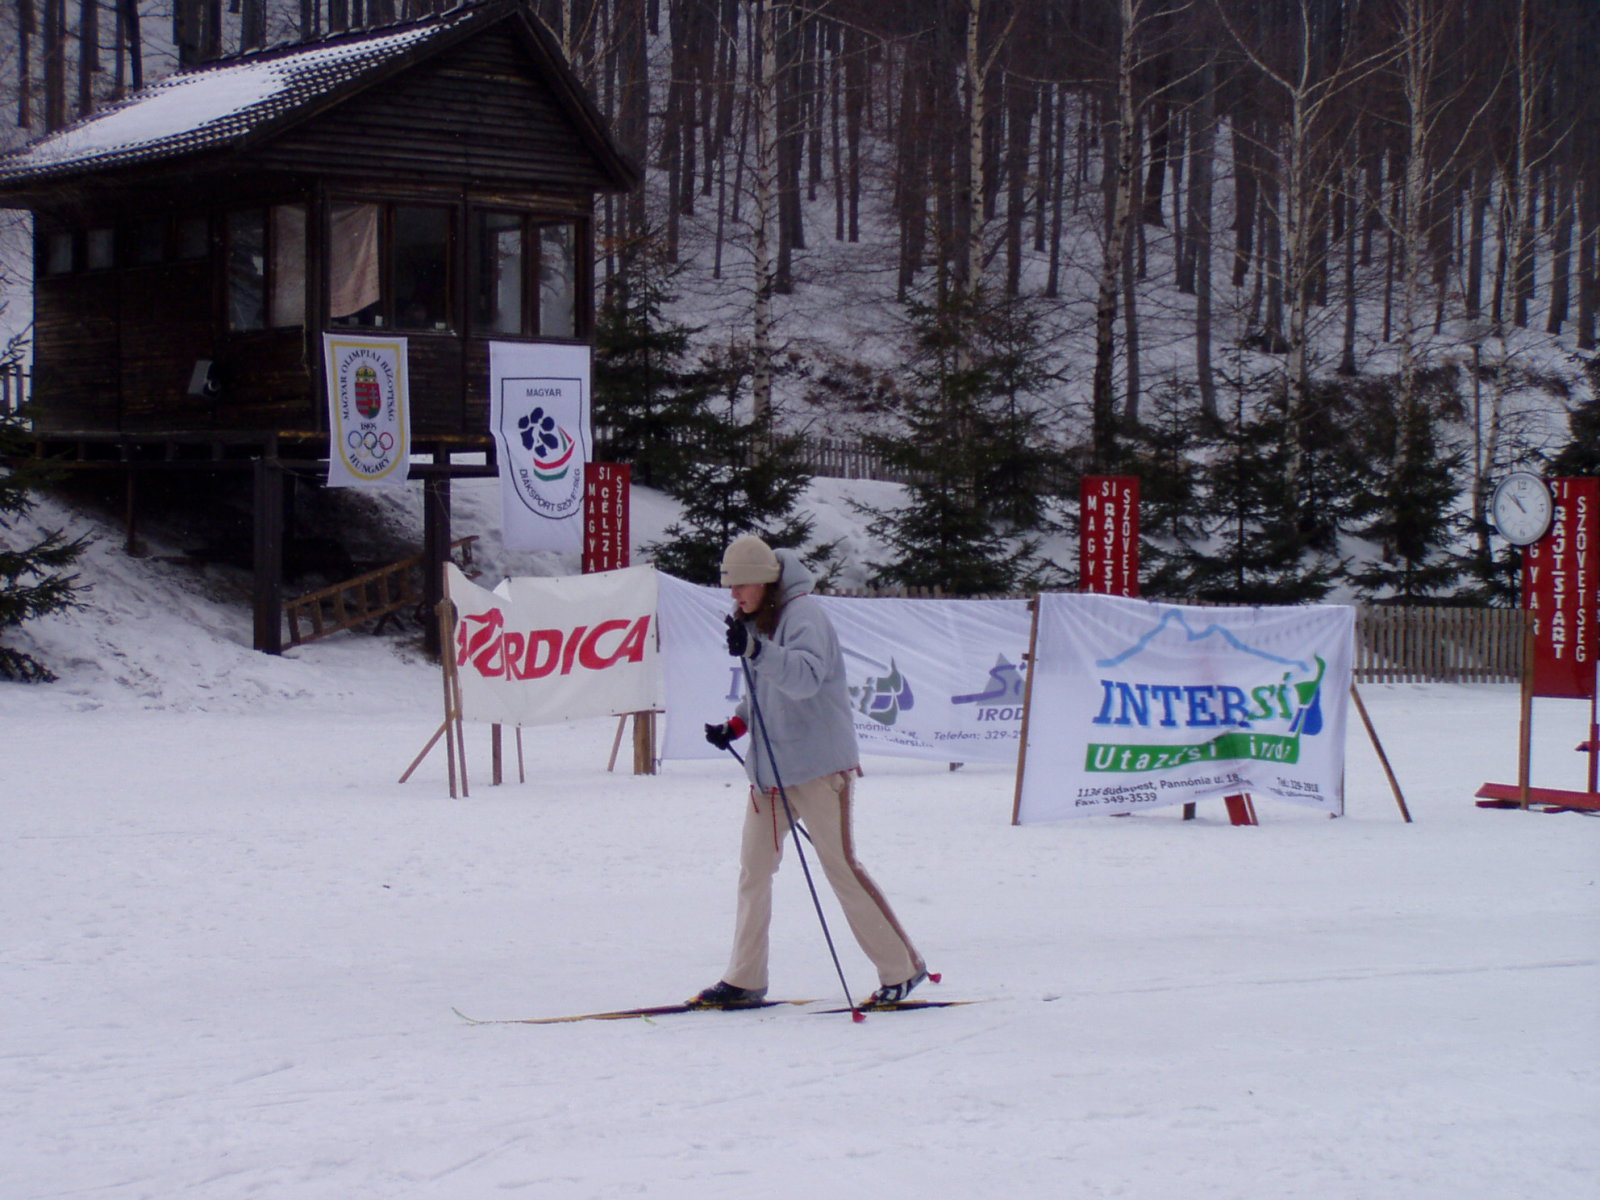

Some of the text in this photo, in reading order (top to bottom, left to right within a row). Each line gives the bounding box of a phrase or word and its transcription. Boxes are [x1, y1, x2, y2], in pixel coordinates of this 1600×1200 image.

[526, 388, 562, 397] MAGYAR
[349, 453, 391, 473] HUNGARY
[588, 483, 596, 572] MAGYA
[1087, 495, 1097, 593] MAGYA
[1103, 502, 1115, 594] RAJT-ST
[977, 708, 1025, 721] IROD
[984, 730, 1021, 741] 329-2
[1102, 781, 1158, 796] Budapest,
[1159, 776, 1211, 789] Pannónia
[1103, 792, 1158, 804] 349-3539
